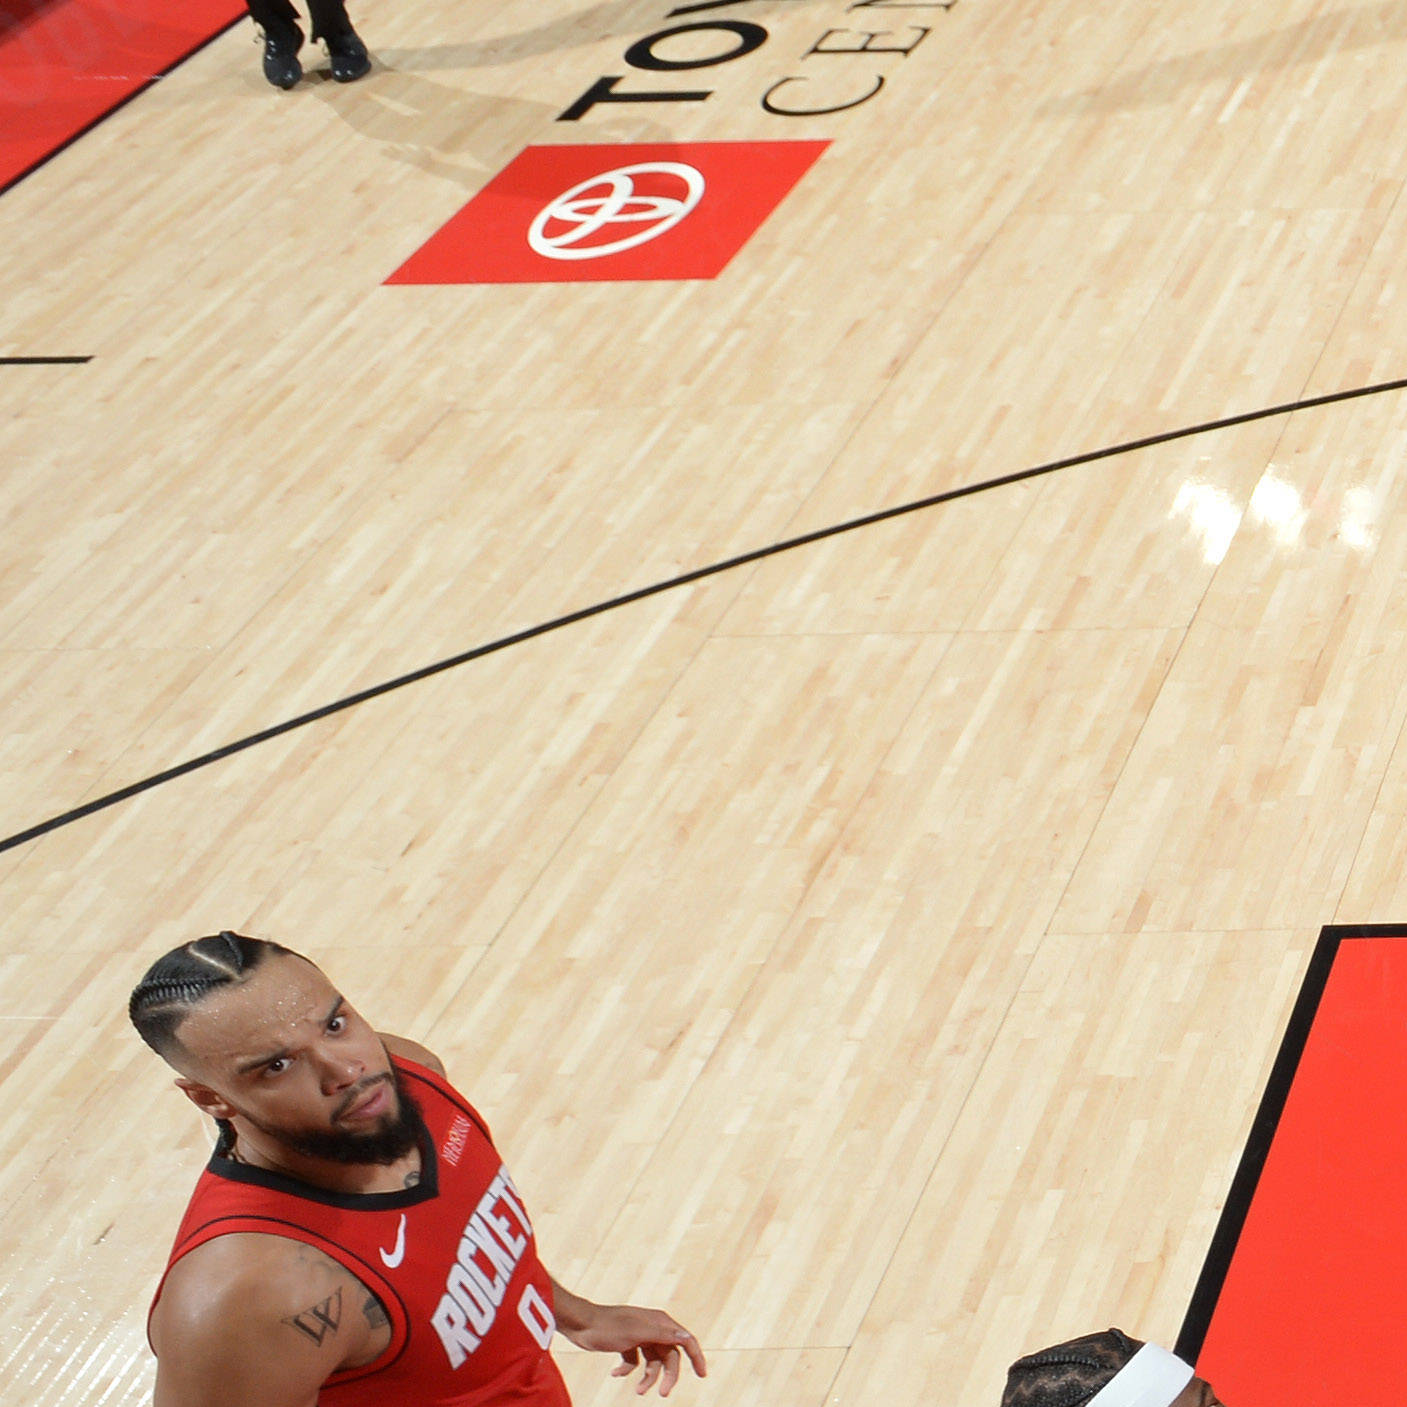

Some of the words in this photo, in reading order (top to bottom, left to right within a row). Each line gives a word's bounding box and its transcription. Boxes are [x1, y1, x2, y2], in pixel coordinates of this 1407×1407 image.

[555, 0, 769, 121] TO
[430, 1162, 534, 1371] ROCKET
[517, 1283, 557, 1351] 0
